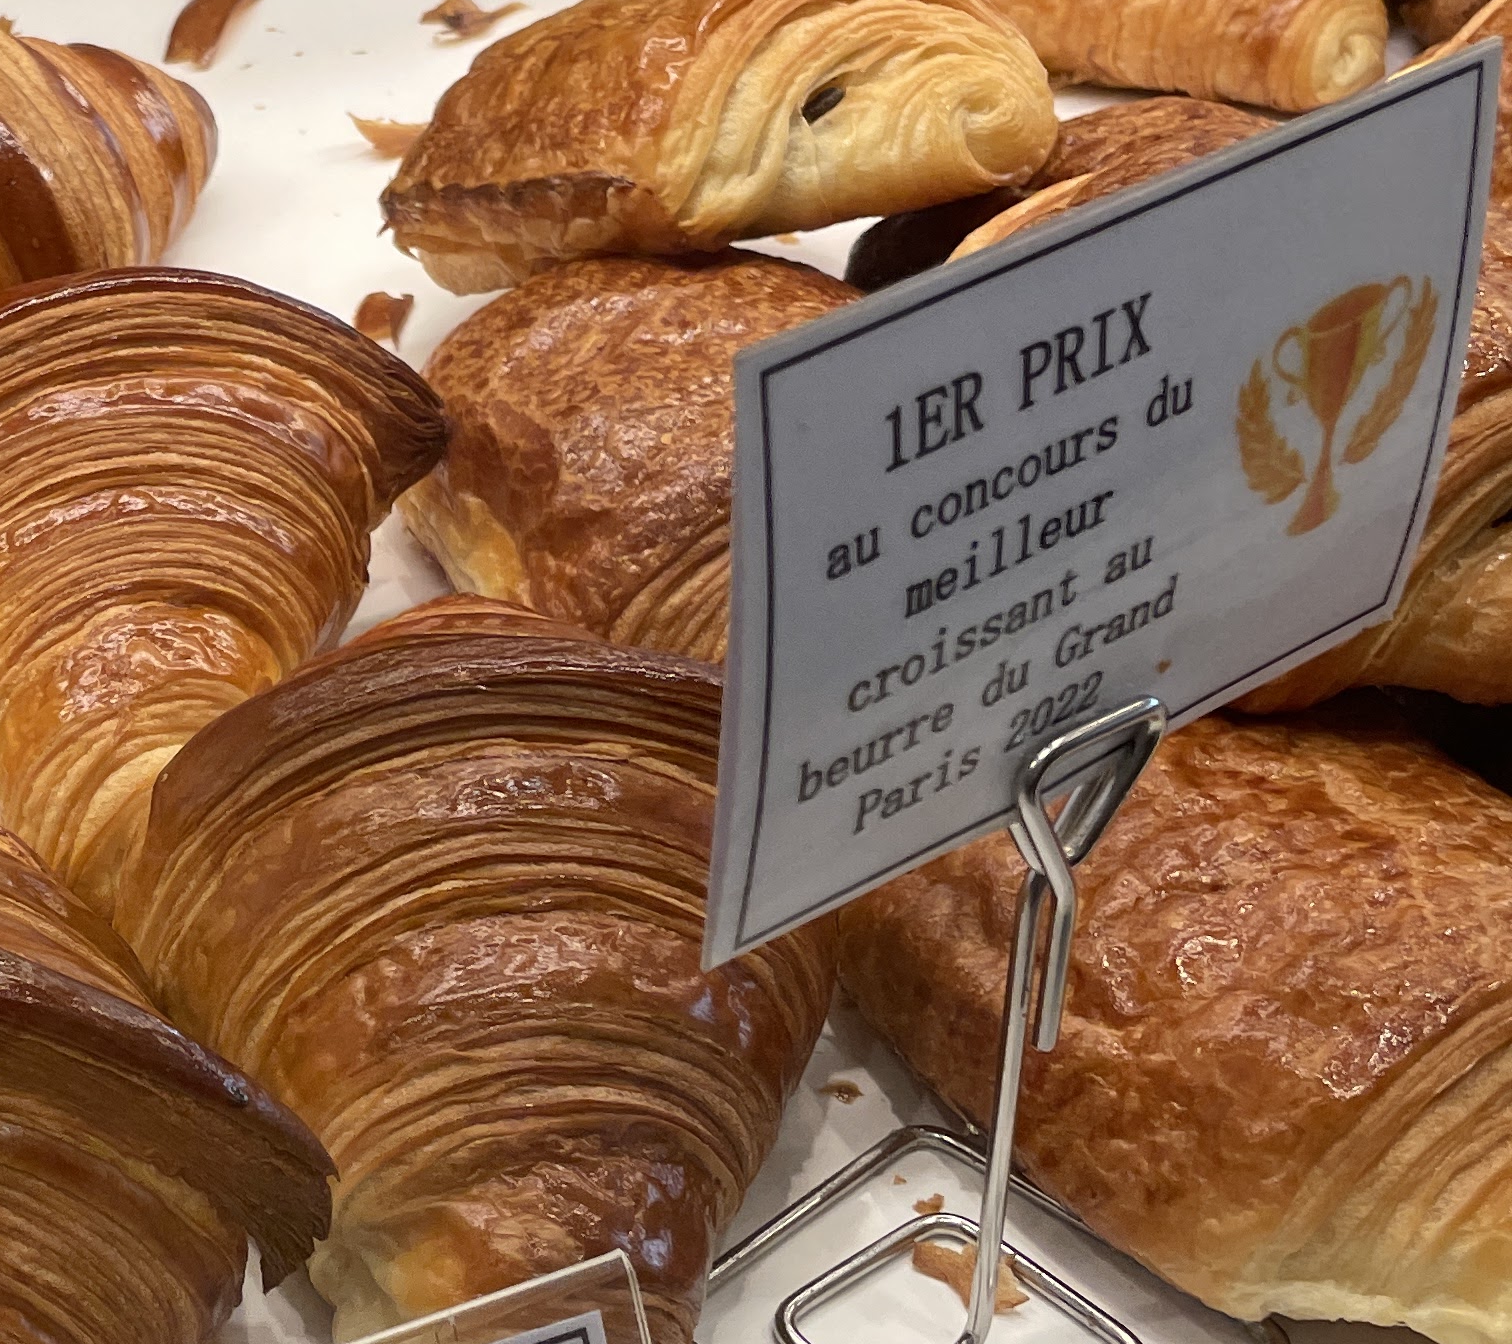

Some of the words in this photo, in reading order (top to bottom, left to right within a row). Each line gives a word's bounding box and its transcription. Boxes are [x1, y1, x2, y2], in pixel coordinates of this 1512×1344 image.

[885, 372, 984, 472] 1ER
[1019, 293, 1154, 409] PRIX
[826, 525, 881, 579] au
[909, 418, 1118, 541] concours
[1146, 374, 1195, 426] du
[904, 488, 1113, 617] meilleur
[797, 706, 954, 803] beurre
[982, 666, 1029, 709] du
[1053, 574, 1179, 668] Grand
[847, 572, 1078, 714] croissant
[1103, 536, 1154, 585] au
[852, 750, 980, 833] Paris
[1003, 671, 1104, 753] 2022
